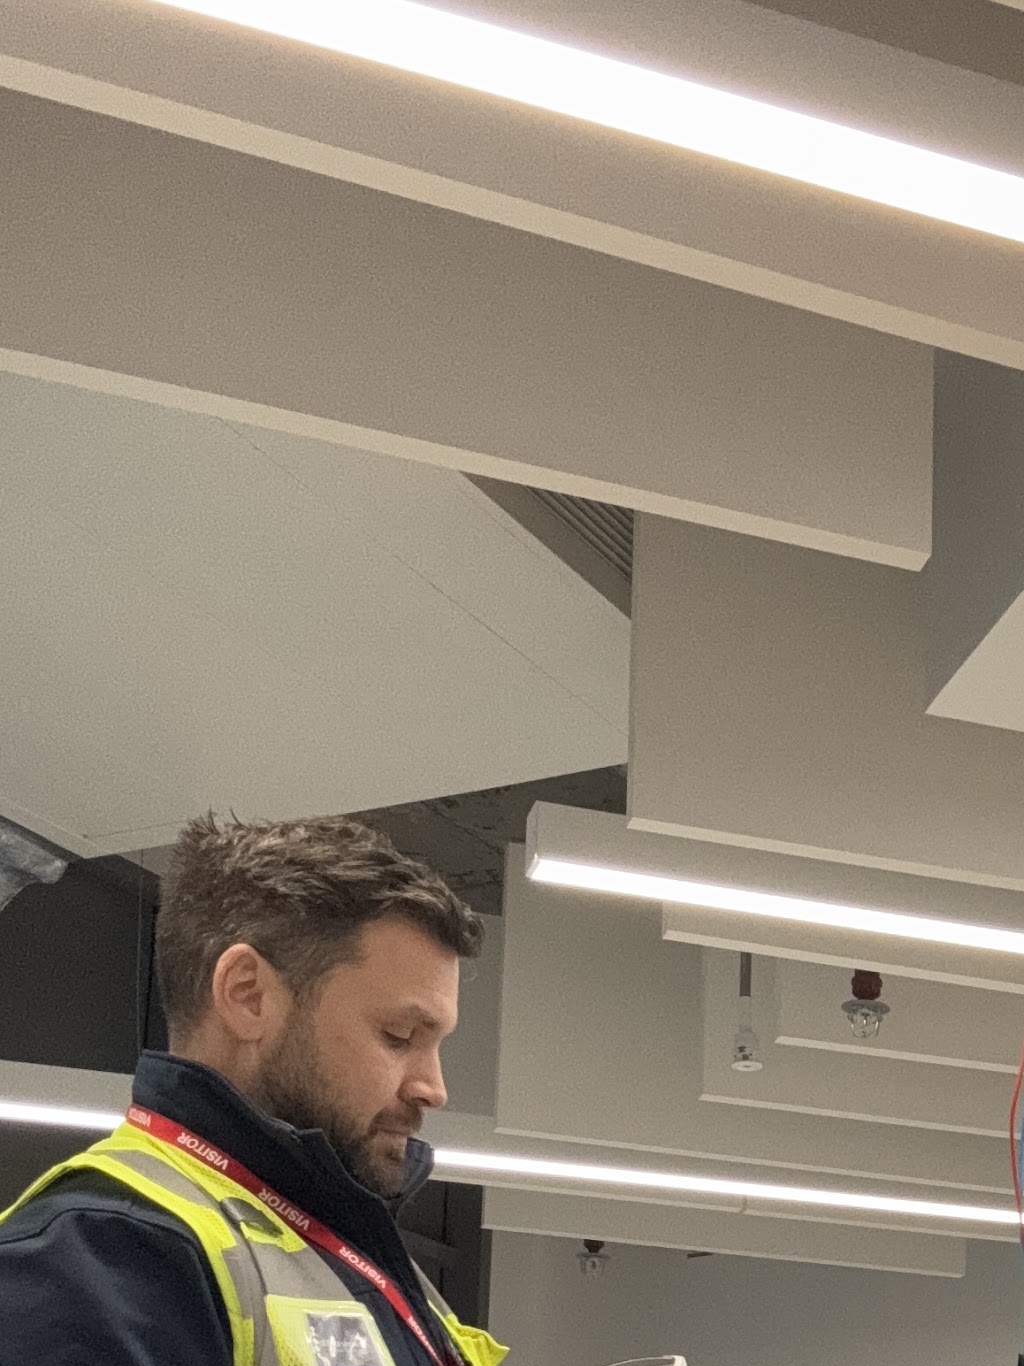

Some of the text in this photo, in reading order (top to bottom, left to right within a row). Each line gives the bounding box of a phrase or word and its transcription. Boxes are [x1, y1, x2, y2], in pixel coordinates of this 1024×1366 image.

[177, 1131, 229, 1171] VISITOR
[257, 1187, 311, 1231] VISITOR
[339, 1246, 387, 1289] VISITOR
